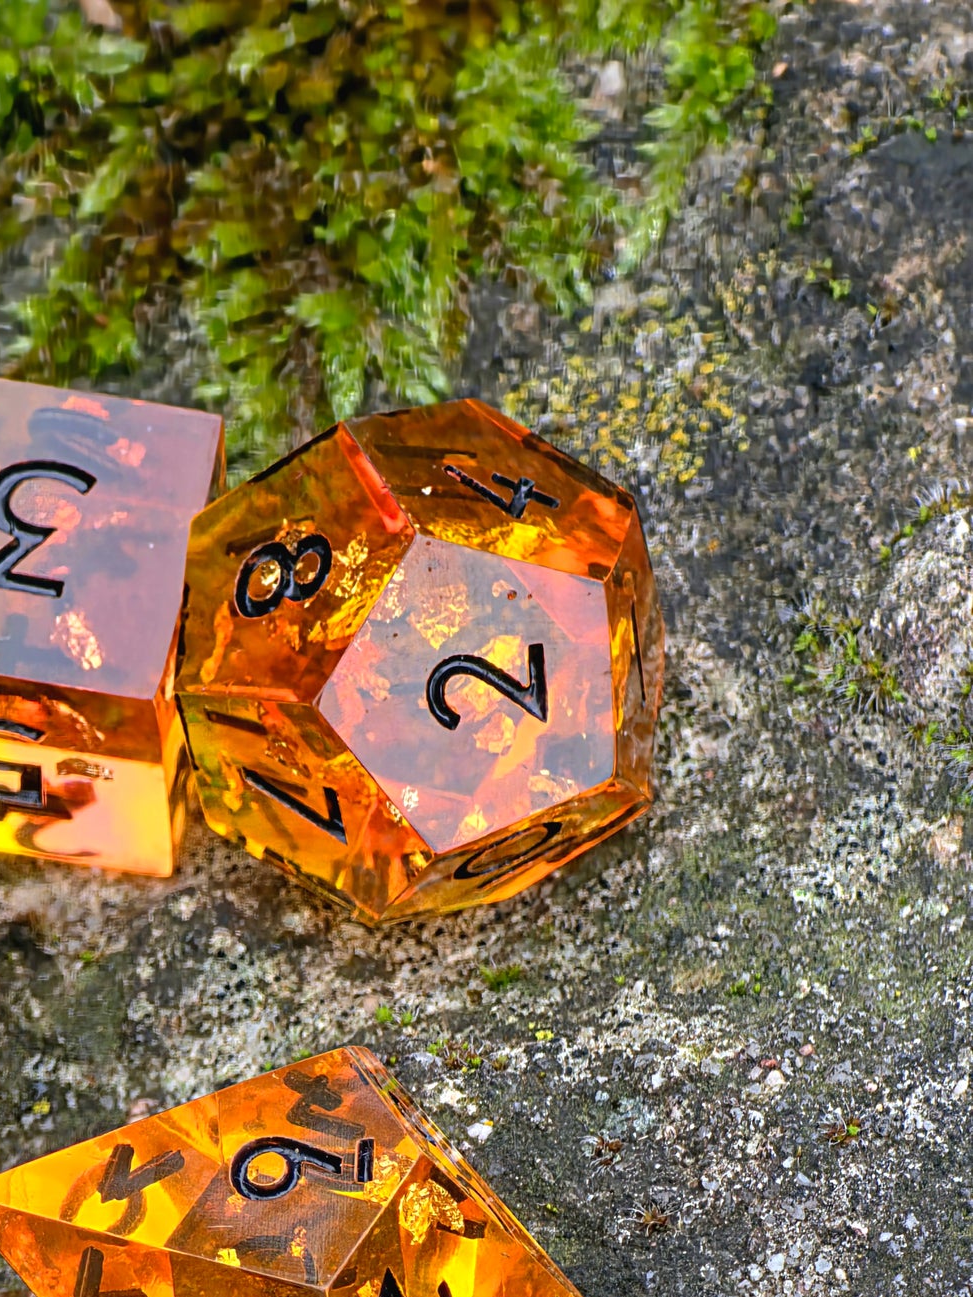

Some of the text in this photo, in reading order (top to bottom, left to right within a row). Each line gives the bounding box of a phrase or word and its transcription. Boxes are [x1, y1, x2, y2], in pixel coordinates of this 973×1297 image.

[443, 464, 560, 519] 4
[234, 532, 333, 619] 8
[426, 642, 548, 731] 2
